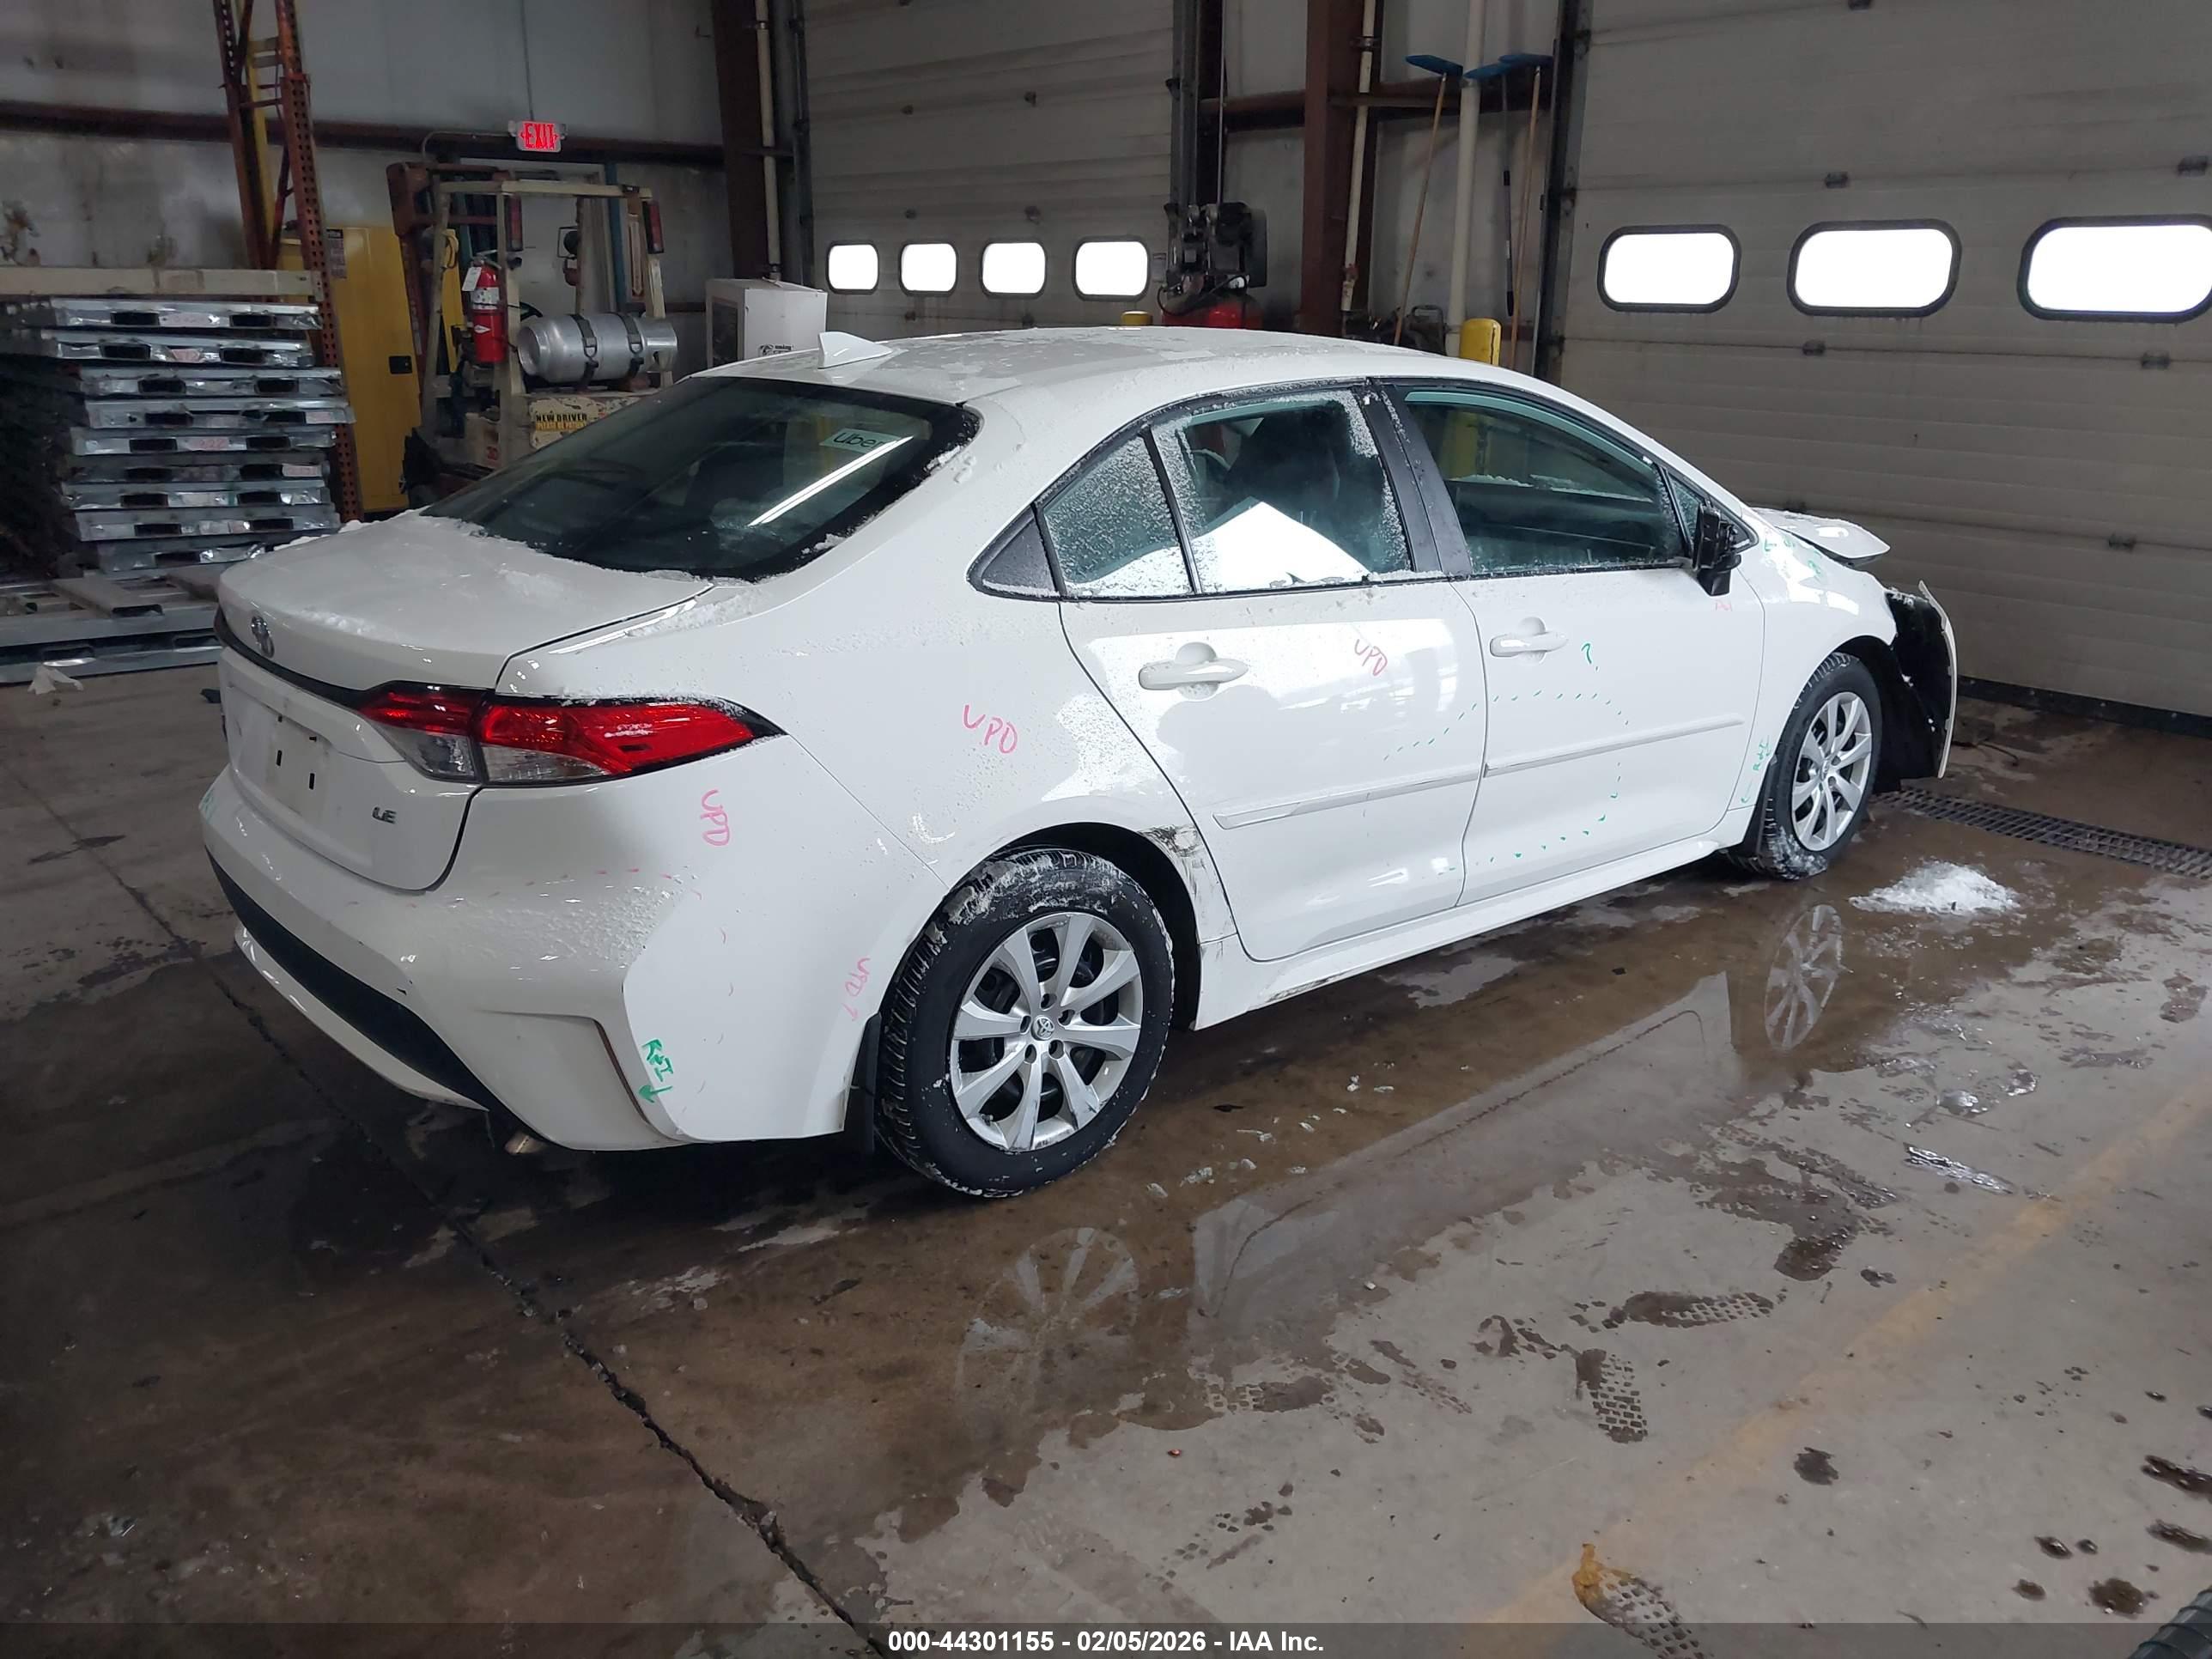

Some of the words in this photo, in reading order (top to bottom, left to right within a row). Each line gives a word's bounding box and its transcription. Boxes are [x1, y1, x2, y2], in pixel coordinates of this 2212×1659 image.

[524, 123, 555, 149] EXIT
[556, 413, 587, 422] DRIVER
[833, 432, 884, 449] Uber
[1354, 639, 1388, 677] UPD
[963, 704, 1018, 754] UPD
[372, 806, 397, 824] LE
[700, 789, 730, 846] UPD
